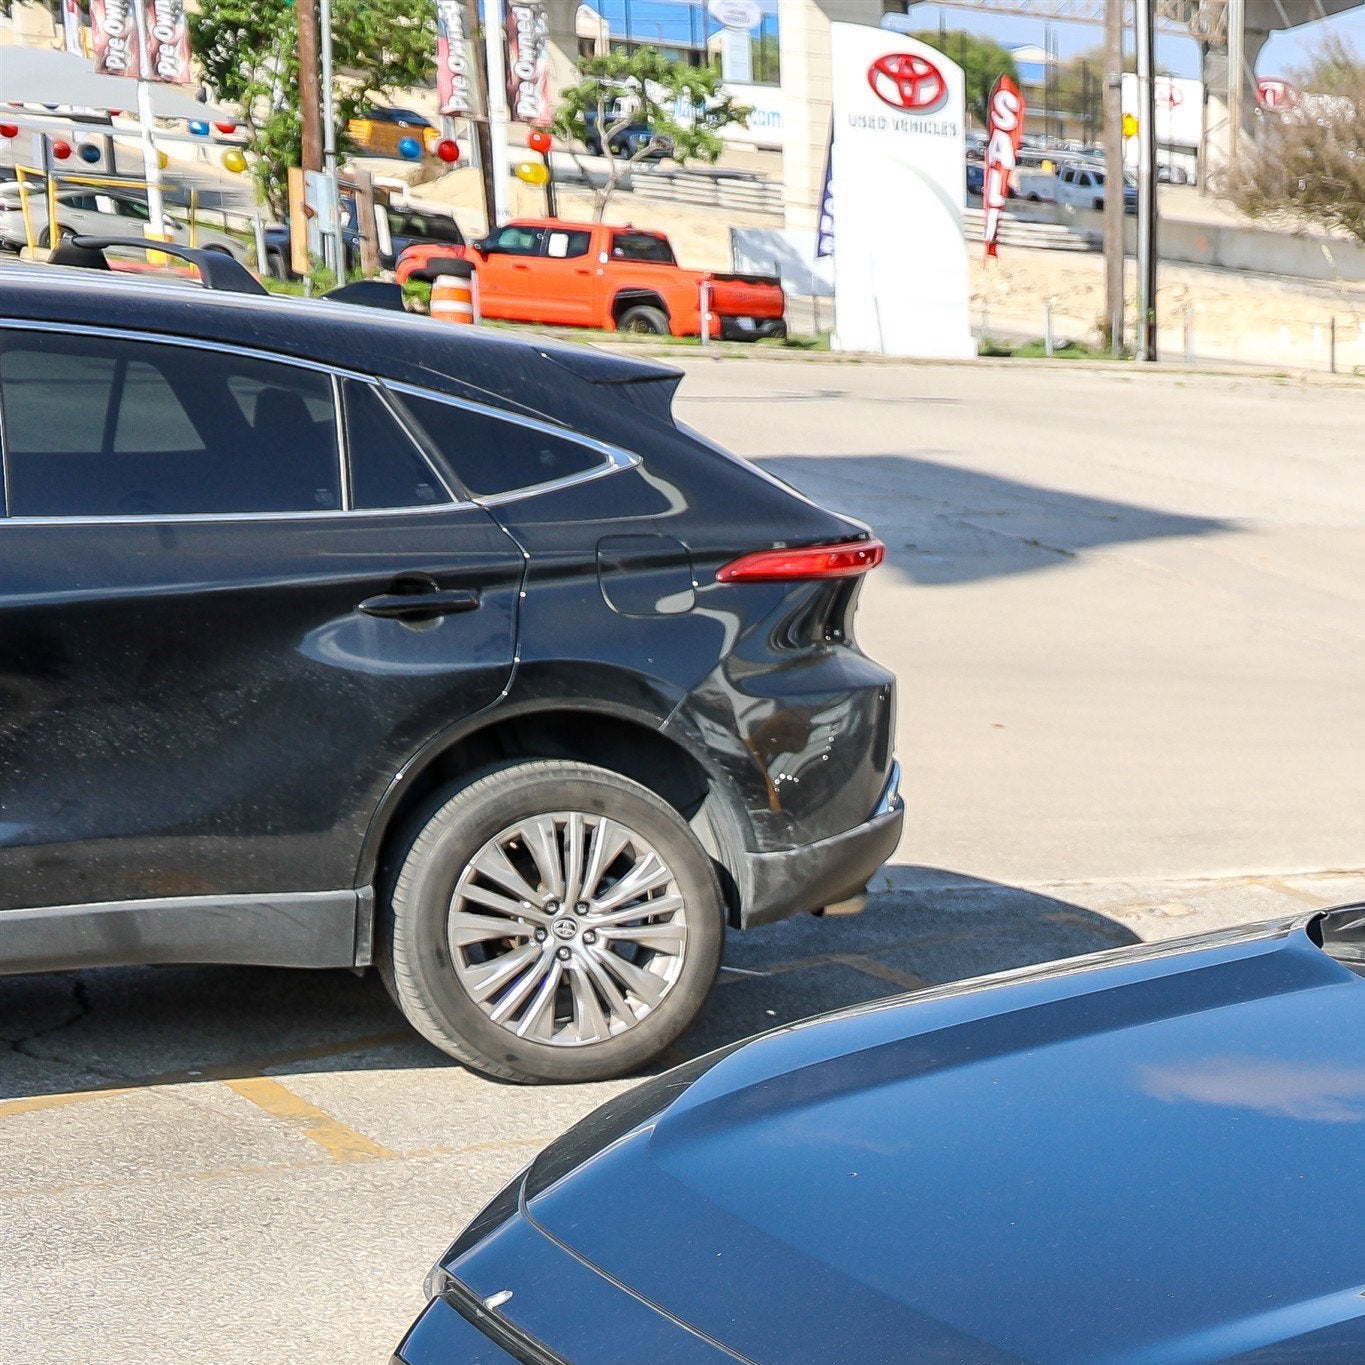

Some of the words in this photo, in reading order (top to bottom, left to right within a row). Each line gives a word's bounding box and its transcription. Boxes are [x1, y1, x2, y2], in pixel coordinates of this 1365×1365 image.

[152, 0, 174, 42] Own
[106, 38, 126, 70] Pre
[157, 43, 178, 77] Pre
[448, 75, 470, 112] Pre
[517, 81, 538, 117] Pre
[848, 114, 888, 130] USED
[892, 118, 957, 139] VEHICLES
